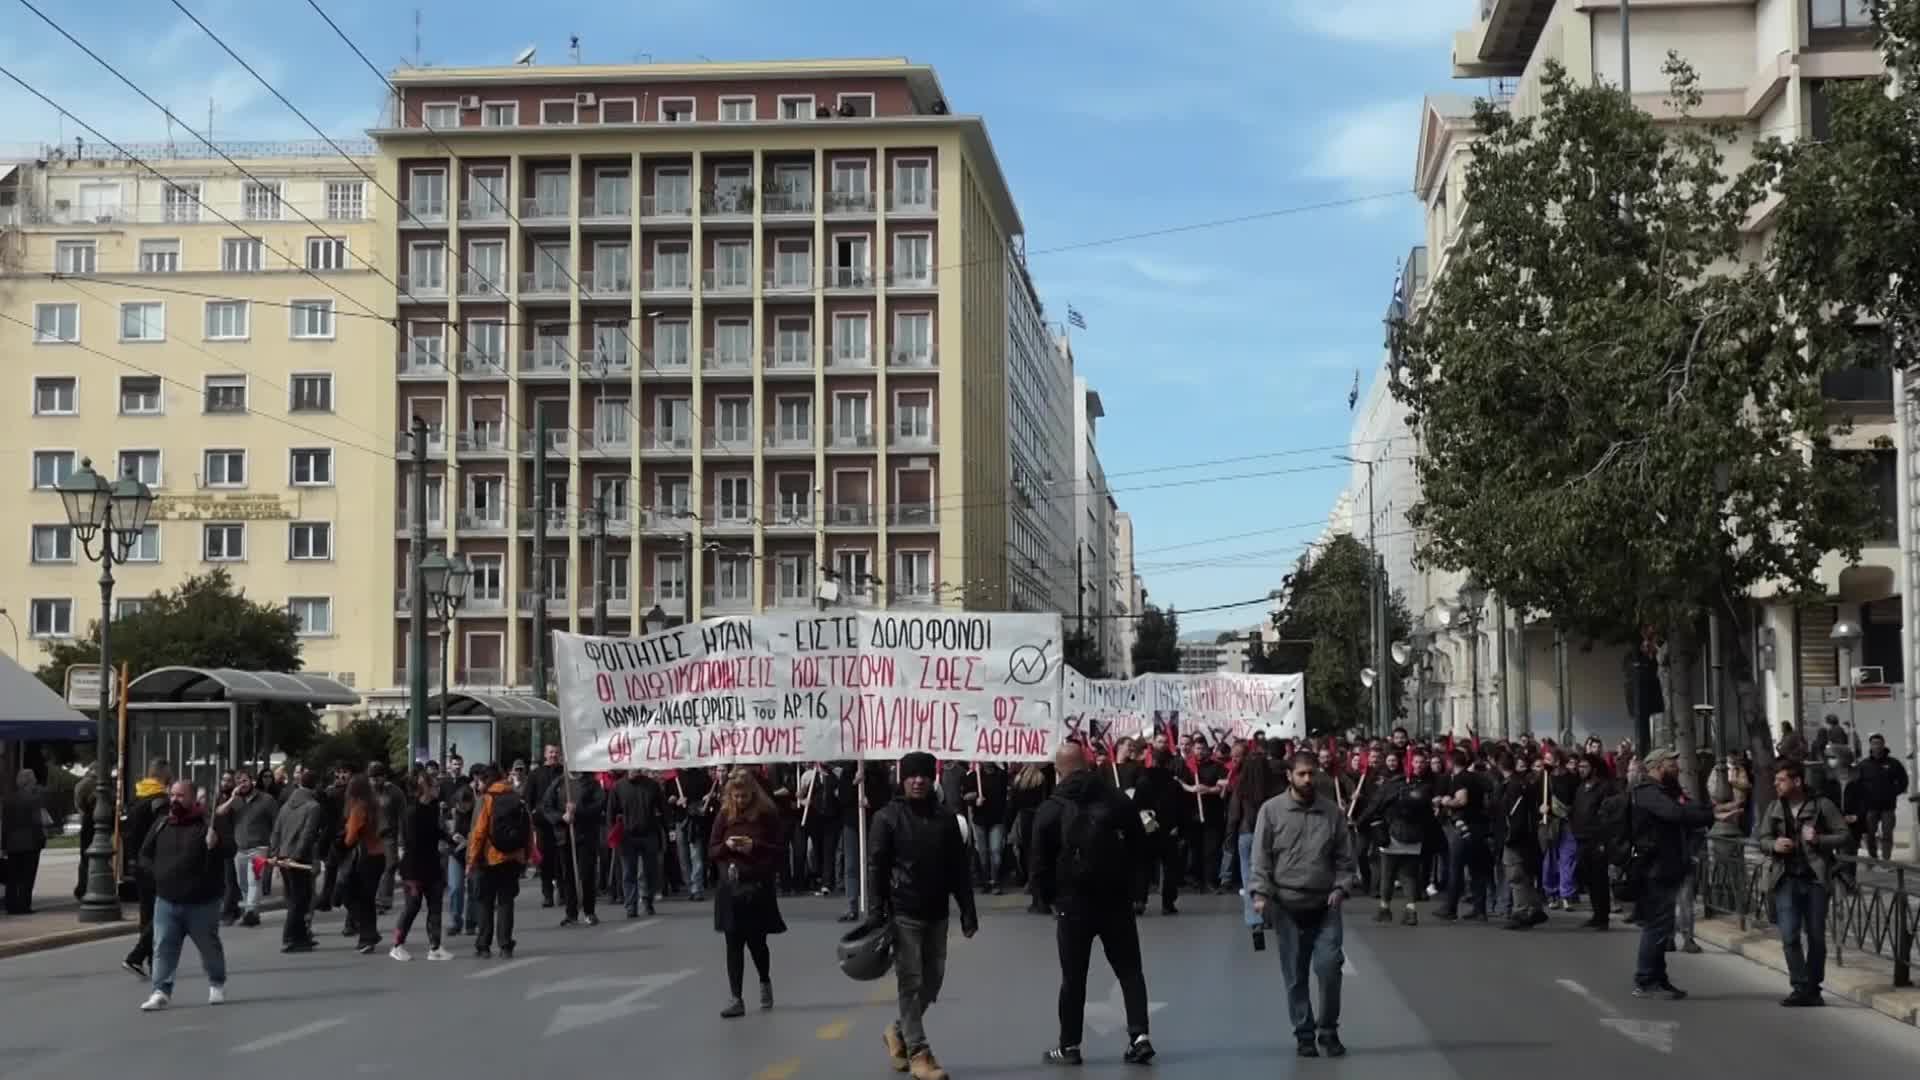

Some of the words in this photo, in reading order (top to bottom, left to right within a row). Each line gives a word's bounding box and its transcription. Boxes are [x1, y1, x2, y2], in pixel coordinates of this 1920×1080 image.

[584, 631, 691, 672] ΦΟΙΤΗΤΕΣ
[702, 620, 754, 655] ΗΤΑΝ
[795, 617, 857, 651] ΕΙΣΤΕ
[871, 617, 992, 651] ΔΟΛΟΦΟΝΟΙ
[596, 672, 616, 703] ΟΙ
[624, 656, 776, 701] ΙΔΙΩΤΙΚΟΠΟΙΗΣΕΙΣ
[792, 654, 895, 689] ΚΟΣΤΙΖΟΥΝ
[919, 656, 985, 691] ΖΩΕΣ
[646, 729, 687, 761] ΣΑΣ
[697, 726, 806, 759] ΣΑΡΩΣΟΥΜΕ
[839, 694, 964, 753] ΚΑΤΑΛΗΨΕΙΣ
[976, 727, 1051, 756] ΑΘΗΝΑΣ
